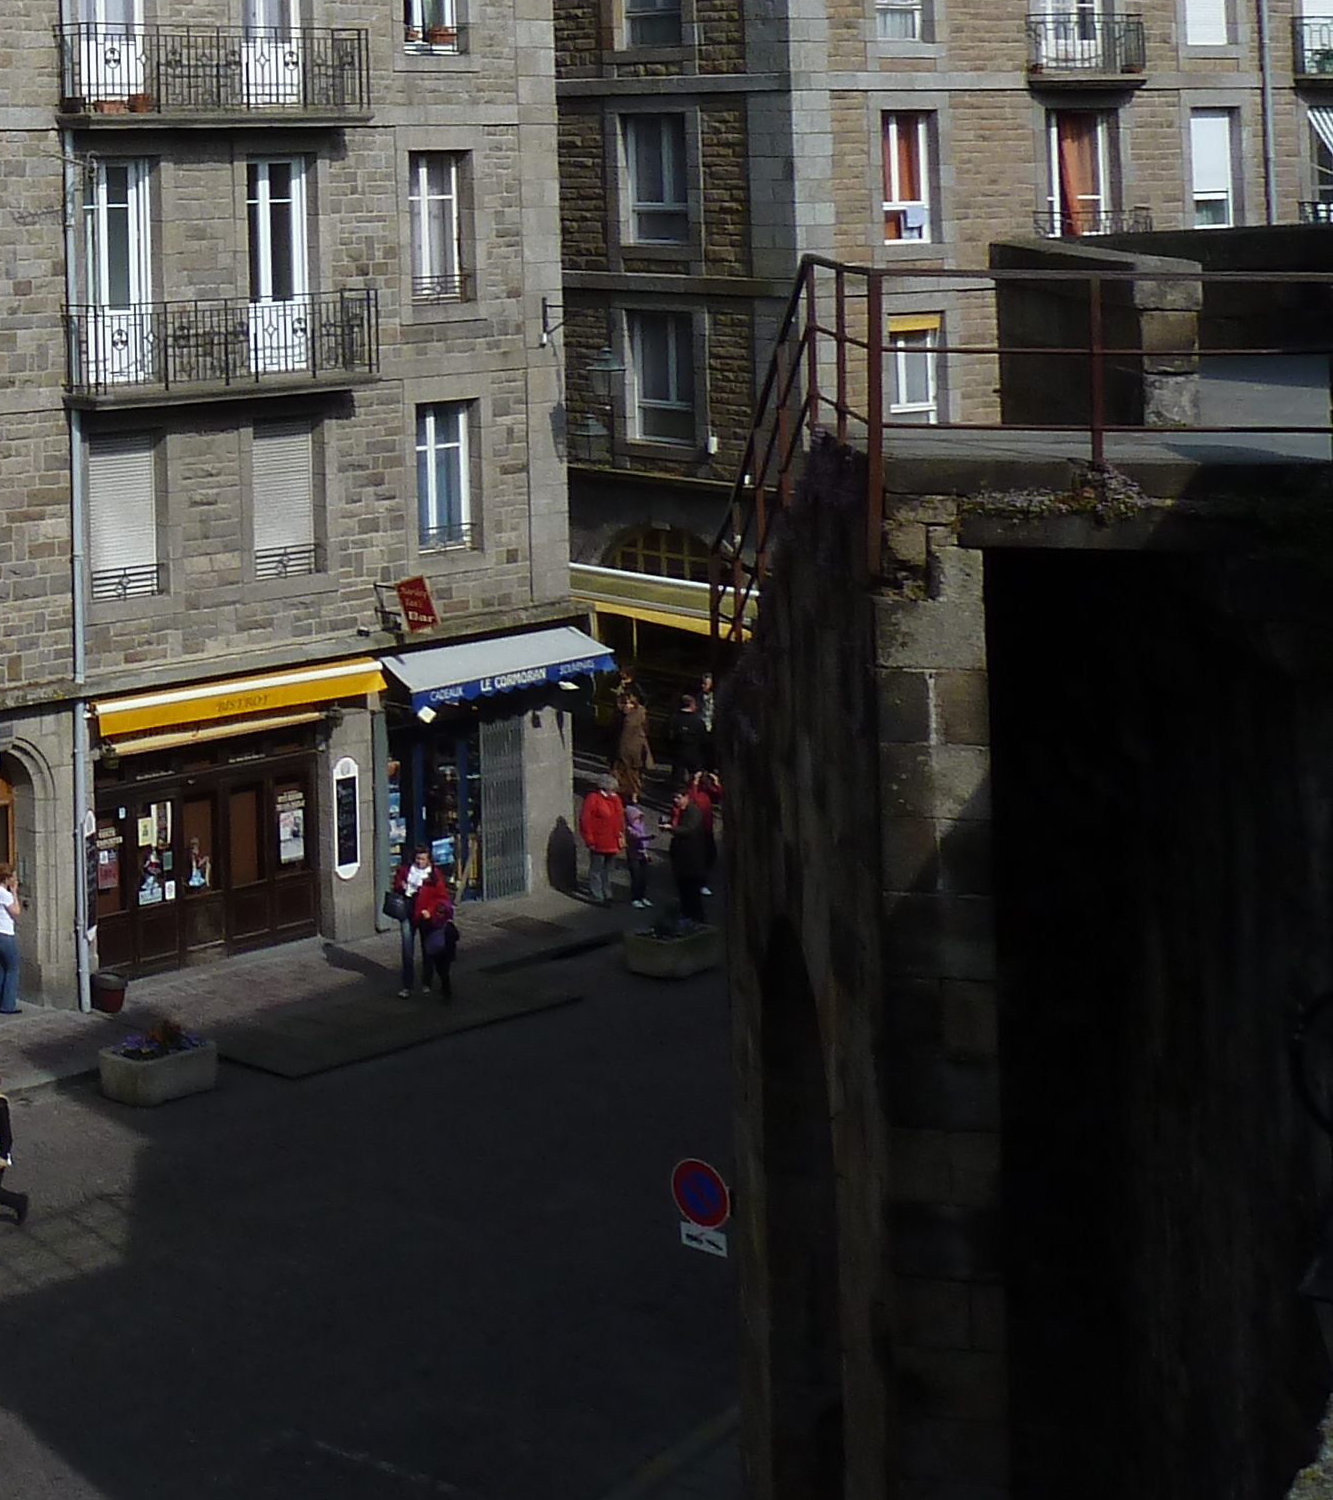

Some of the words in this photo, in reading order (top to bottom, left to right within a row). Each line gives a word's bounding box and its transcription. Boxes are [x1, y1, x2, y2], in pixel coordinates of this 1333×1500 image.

[409, 611, 435, 623] Bar
[480, 680, 493, 692] LE
[494, 667, 547, 688] CORMORAN
[429, 686, 465, 702] CADEAUX
[217, 695, 270, 713] BISTROT
